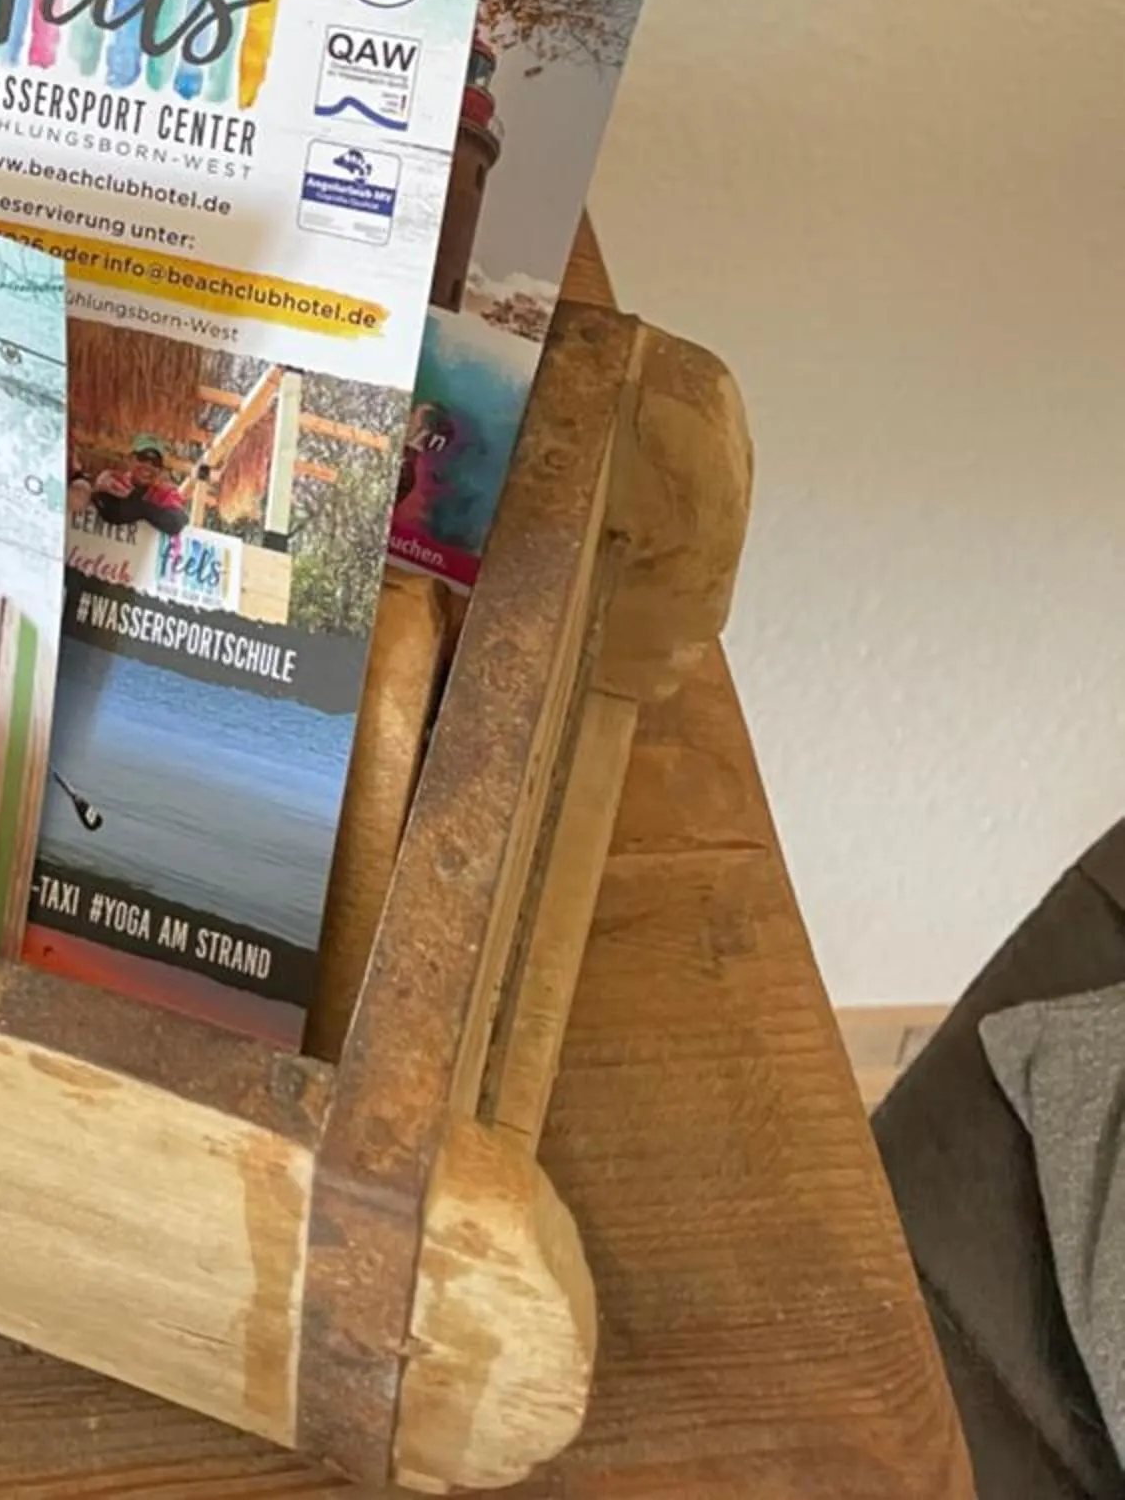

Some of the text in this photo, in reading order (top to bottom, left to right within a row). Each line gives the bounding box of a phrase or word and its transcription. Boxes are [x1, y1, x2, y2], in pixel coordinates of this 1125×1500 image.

[328, 32, 418, 72] QAW
[157, 103, 257, 157] CENTER
[131, 223, 196, 250] unter:
[49, 244, 101, 270] oder
[104, 255, 377, 329] info@beachclubhotel.de
[76, 592, 297, 684] #WASSERSPORTSCHULE
[88, 892, 151, 942] #YOGA
[157, 915, 190, 953] AM
[195, 927, 272, 980] STRAND
